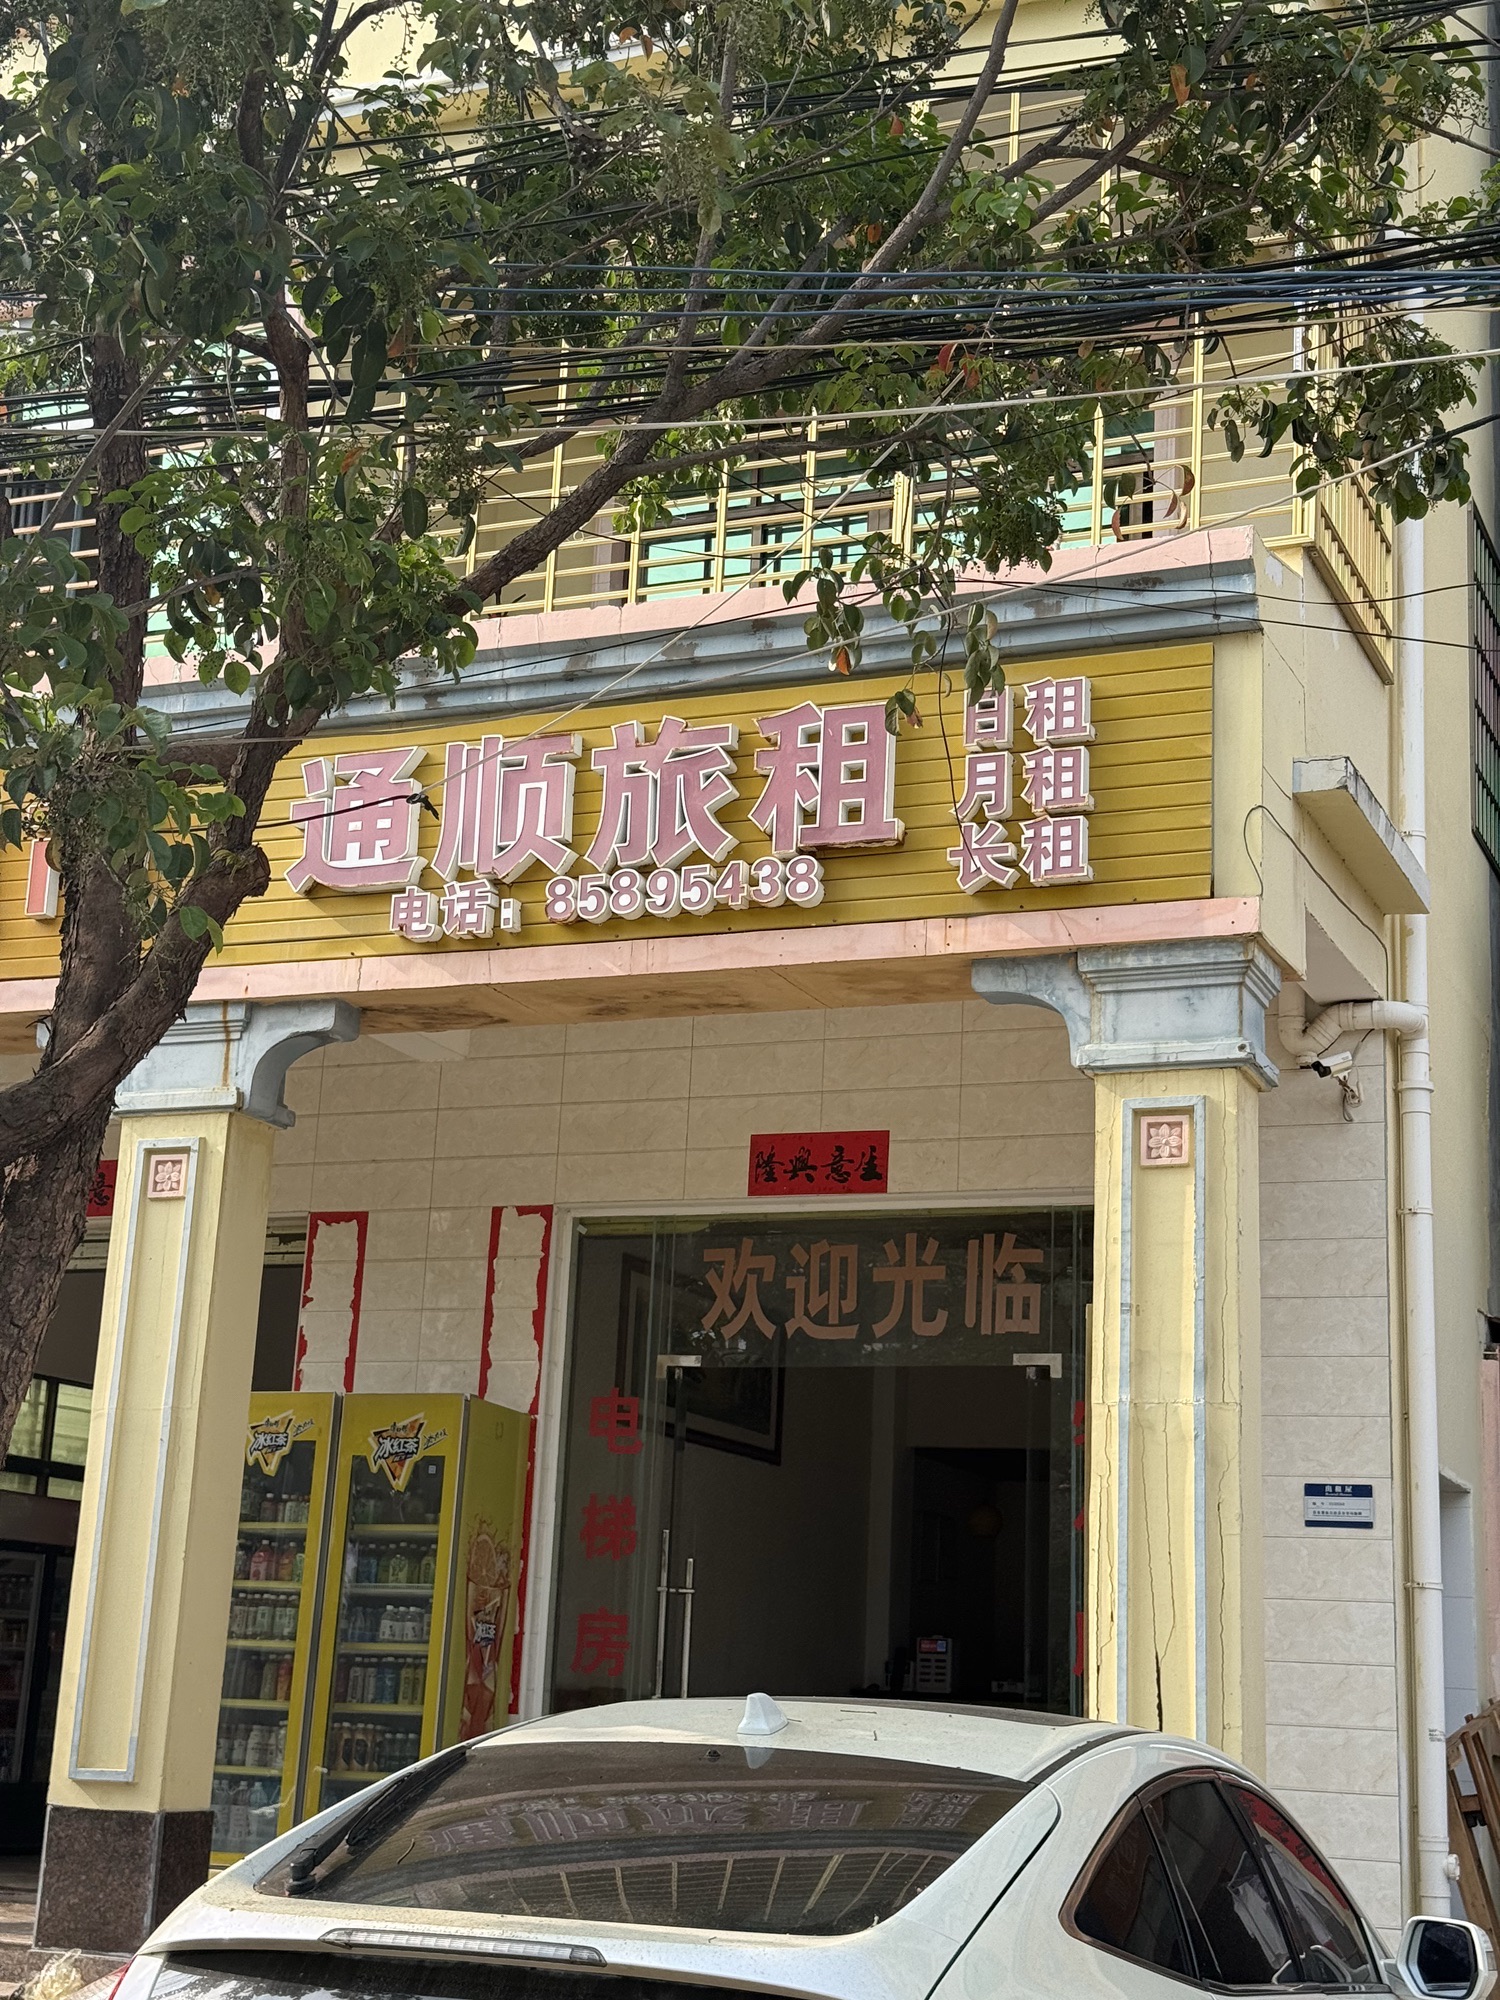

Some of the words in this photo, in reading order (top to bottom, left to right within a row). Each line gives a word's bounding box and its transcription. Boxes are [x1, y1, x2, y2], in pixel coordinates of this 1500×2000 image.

[963, 675, 1096, 752] 日租
[285, 701, 905, 894] 通顺旅租
[950, 745, 1095, 821] 月租
[546, 855, 825, 923] 85895438
[947, 815, 1094, 894] 长租
[701, 1232, 1045, 1341] 欢迎光临
[374, 1436, 419, 1464] 冰红茶
[569, 1386, 644, 1679] 电梯房
